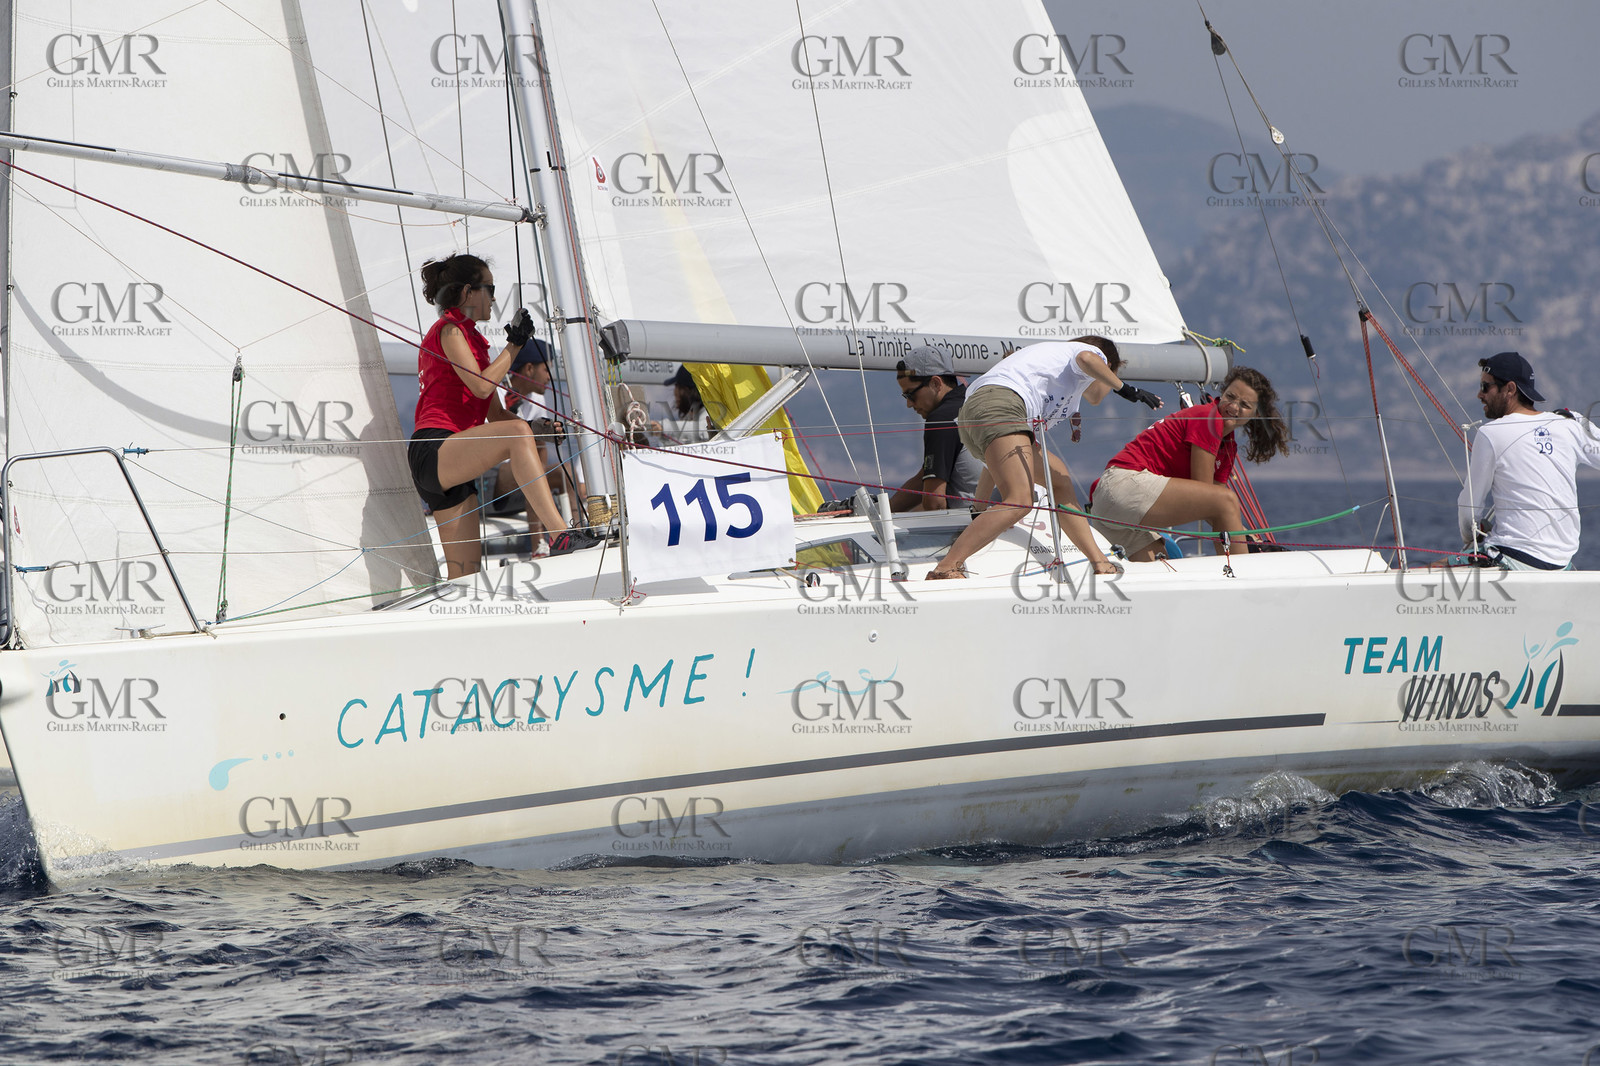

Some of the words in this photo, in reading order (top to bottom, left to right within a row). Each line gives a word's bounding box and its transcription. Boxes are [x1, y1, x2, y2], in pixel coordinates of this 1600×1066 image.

[846, 335, 864, 356] La
[867, 336, 911, 358] Trinité
[1536, 442, 1553, 455] 29
[651, 472, 764, 547] 115
[1344, 635, 1443, 674] TEAM
[337, 653, 714, 748] CATACLYSME
[741, 648, 755, 697] !
[1401, 671, 1500, 722] WINDS
